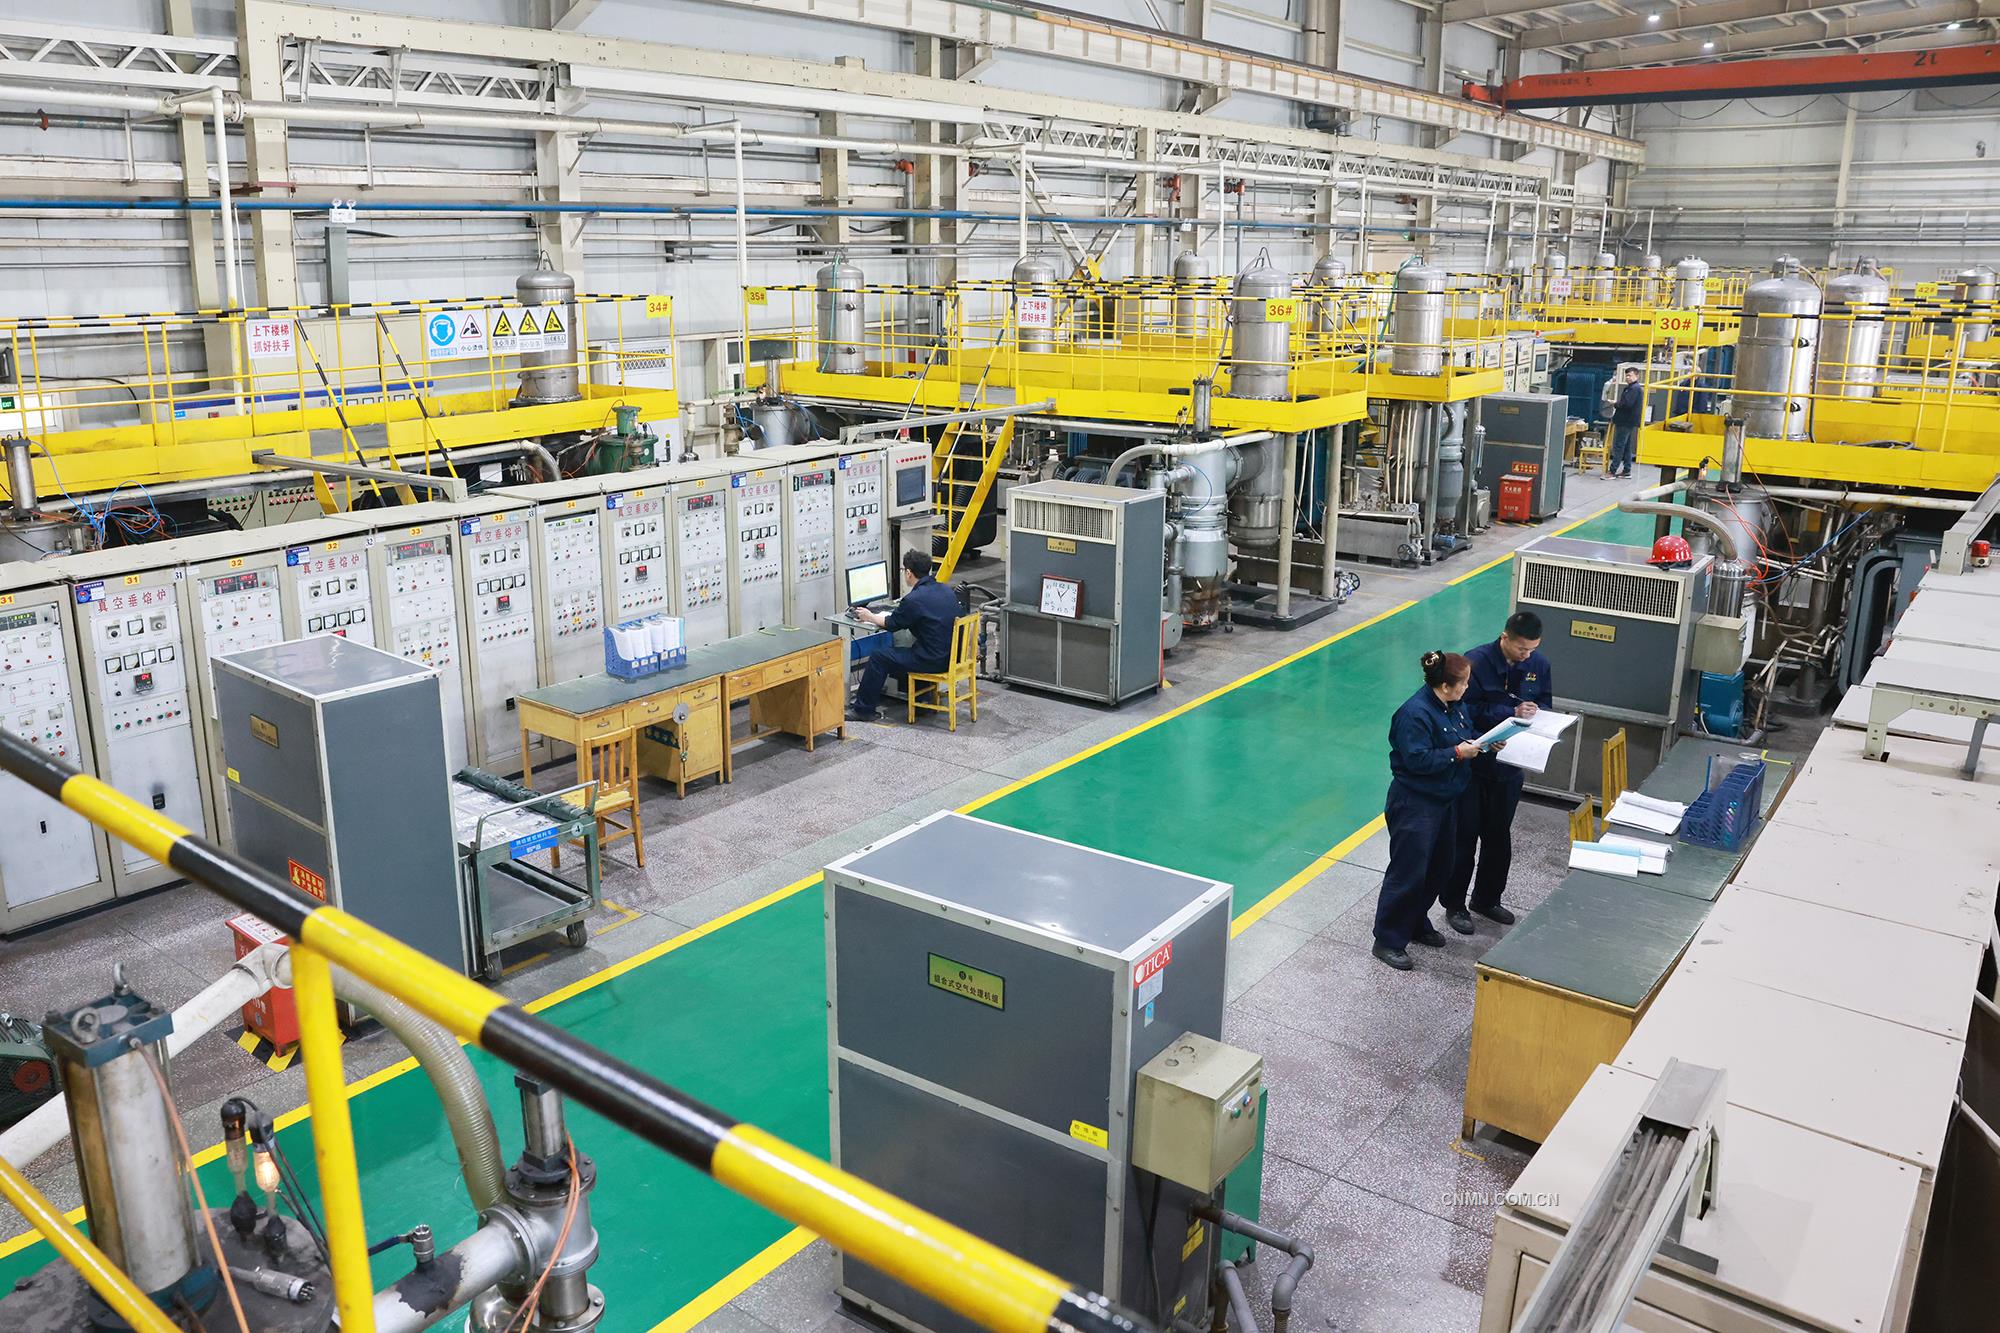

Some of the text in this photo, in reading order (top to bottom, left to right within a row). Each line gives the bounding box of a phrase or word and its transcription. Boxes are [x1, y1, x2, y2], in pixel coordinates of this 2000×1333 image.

[750, 291, 765, 301] 35#
[649, 302, 668, 313] 34#
[1269, 304, 1293, 316] 36#
[253, 324, 289, 336] 上下楼梯
[1660, 317, 1692, 331] 30#
[253, 340, 290, 352] 抓好扶手
[327, 541, 337, 550] 32
[231, 560, 244, 569] 32
[303, 554, 360, 575] 真空垂熔炉
[127, 576, 138, 584] 31
[175, 571, 183, 579] 31
[1, 596, 13, 604] 31
[98, 589, 167, 612] 真空垂熔炉
[1144, 947, 1170, 976] TICA
[934, 973, 999, 1003] 组合式空气处理机组
